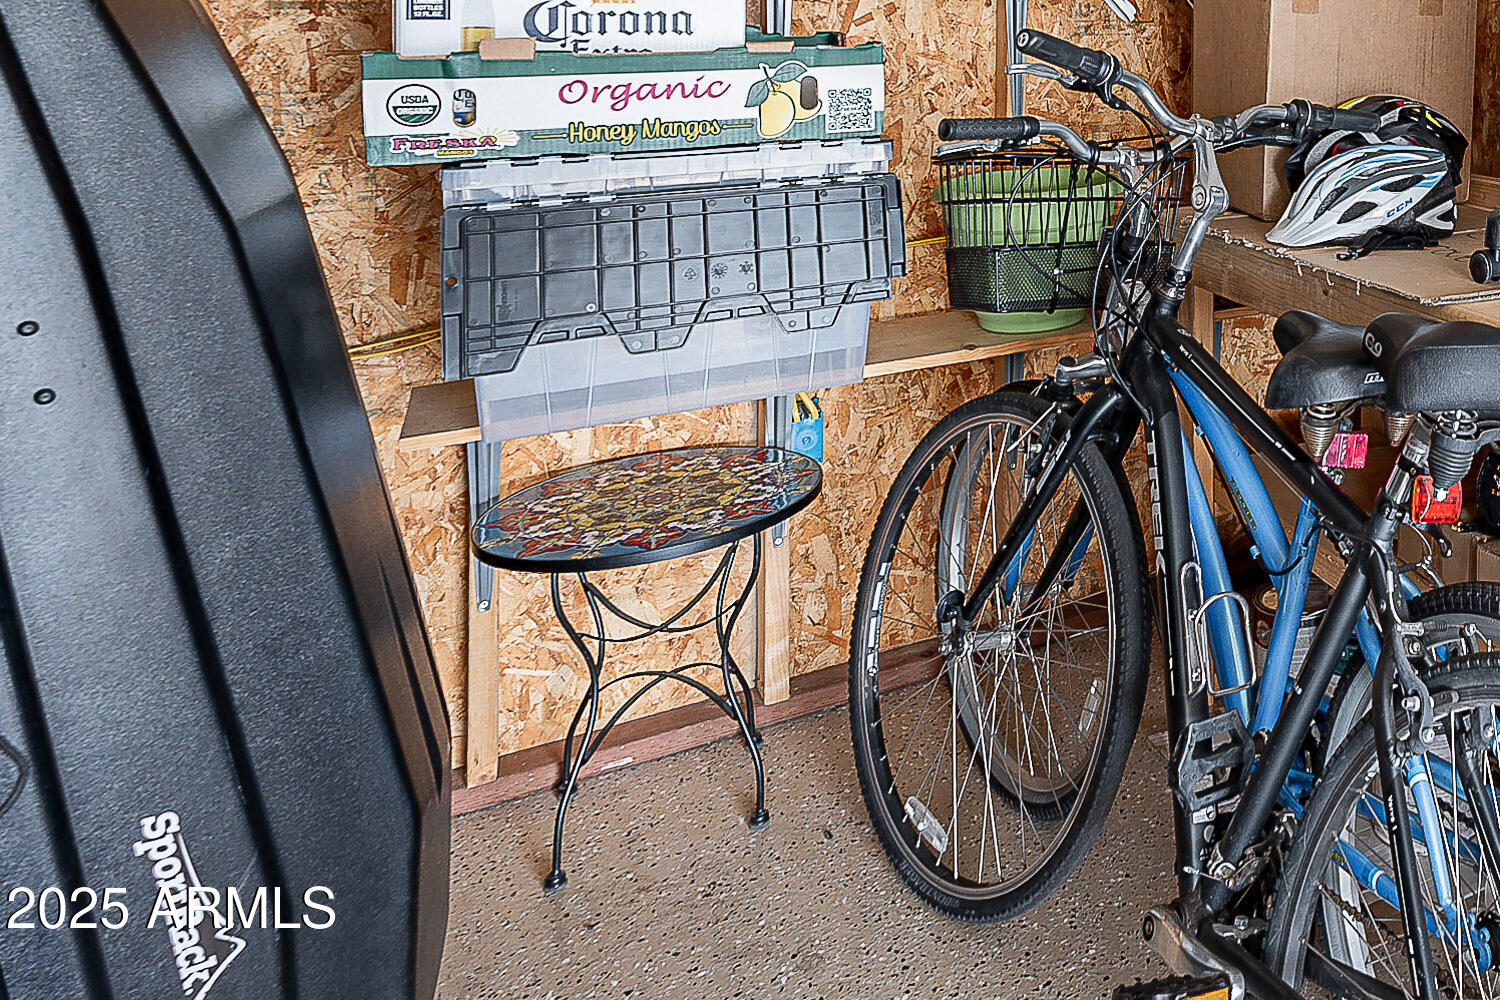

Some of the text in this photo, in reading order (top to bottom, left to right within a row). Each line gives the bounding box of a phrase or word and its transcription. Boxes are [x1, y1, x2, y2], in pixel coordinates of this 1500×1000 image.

[523, 0, 693, 48] Corona
[401, 95, 429, 104] USDA
[558, 75, 732, 112] Organic
[392, 135, 501, 151] FRESKA
[568, 118, 722, 146] Honey Mangos
[1146, 430, 1166, 575] TREK
